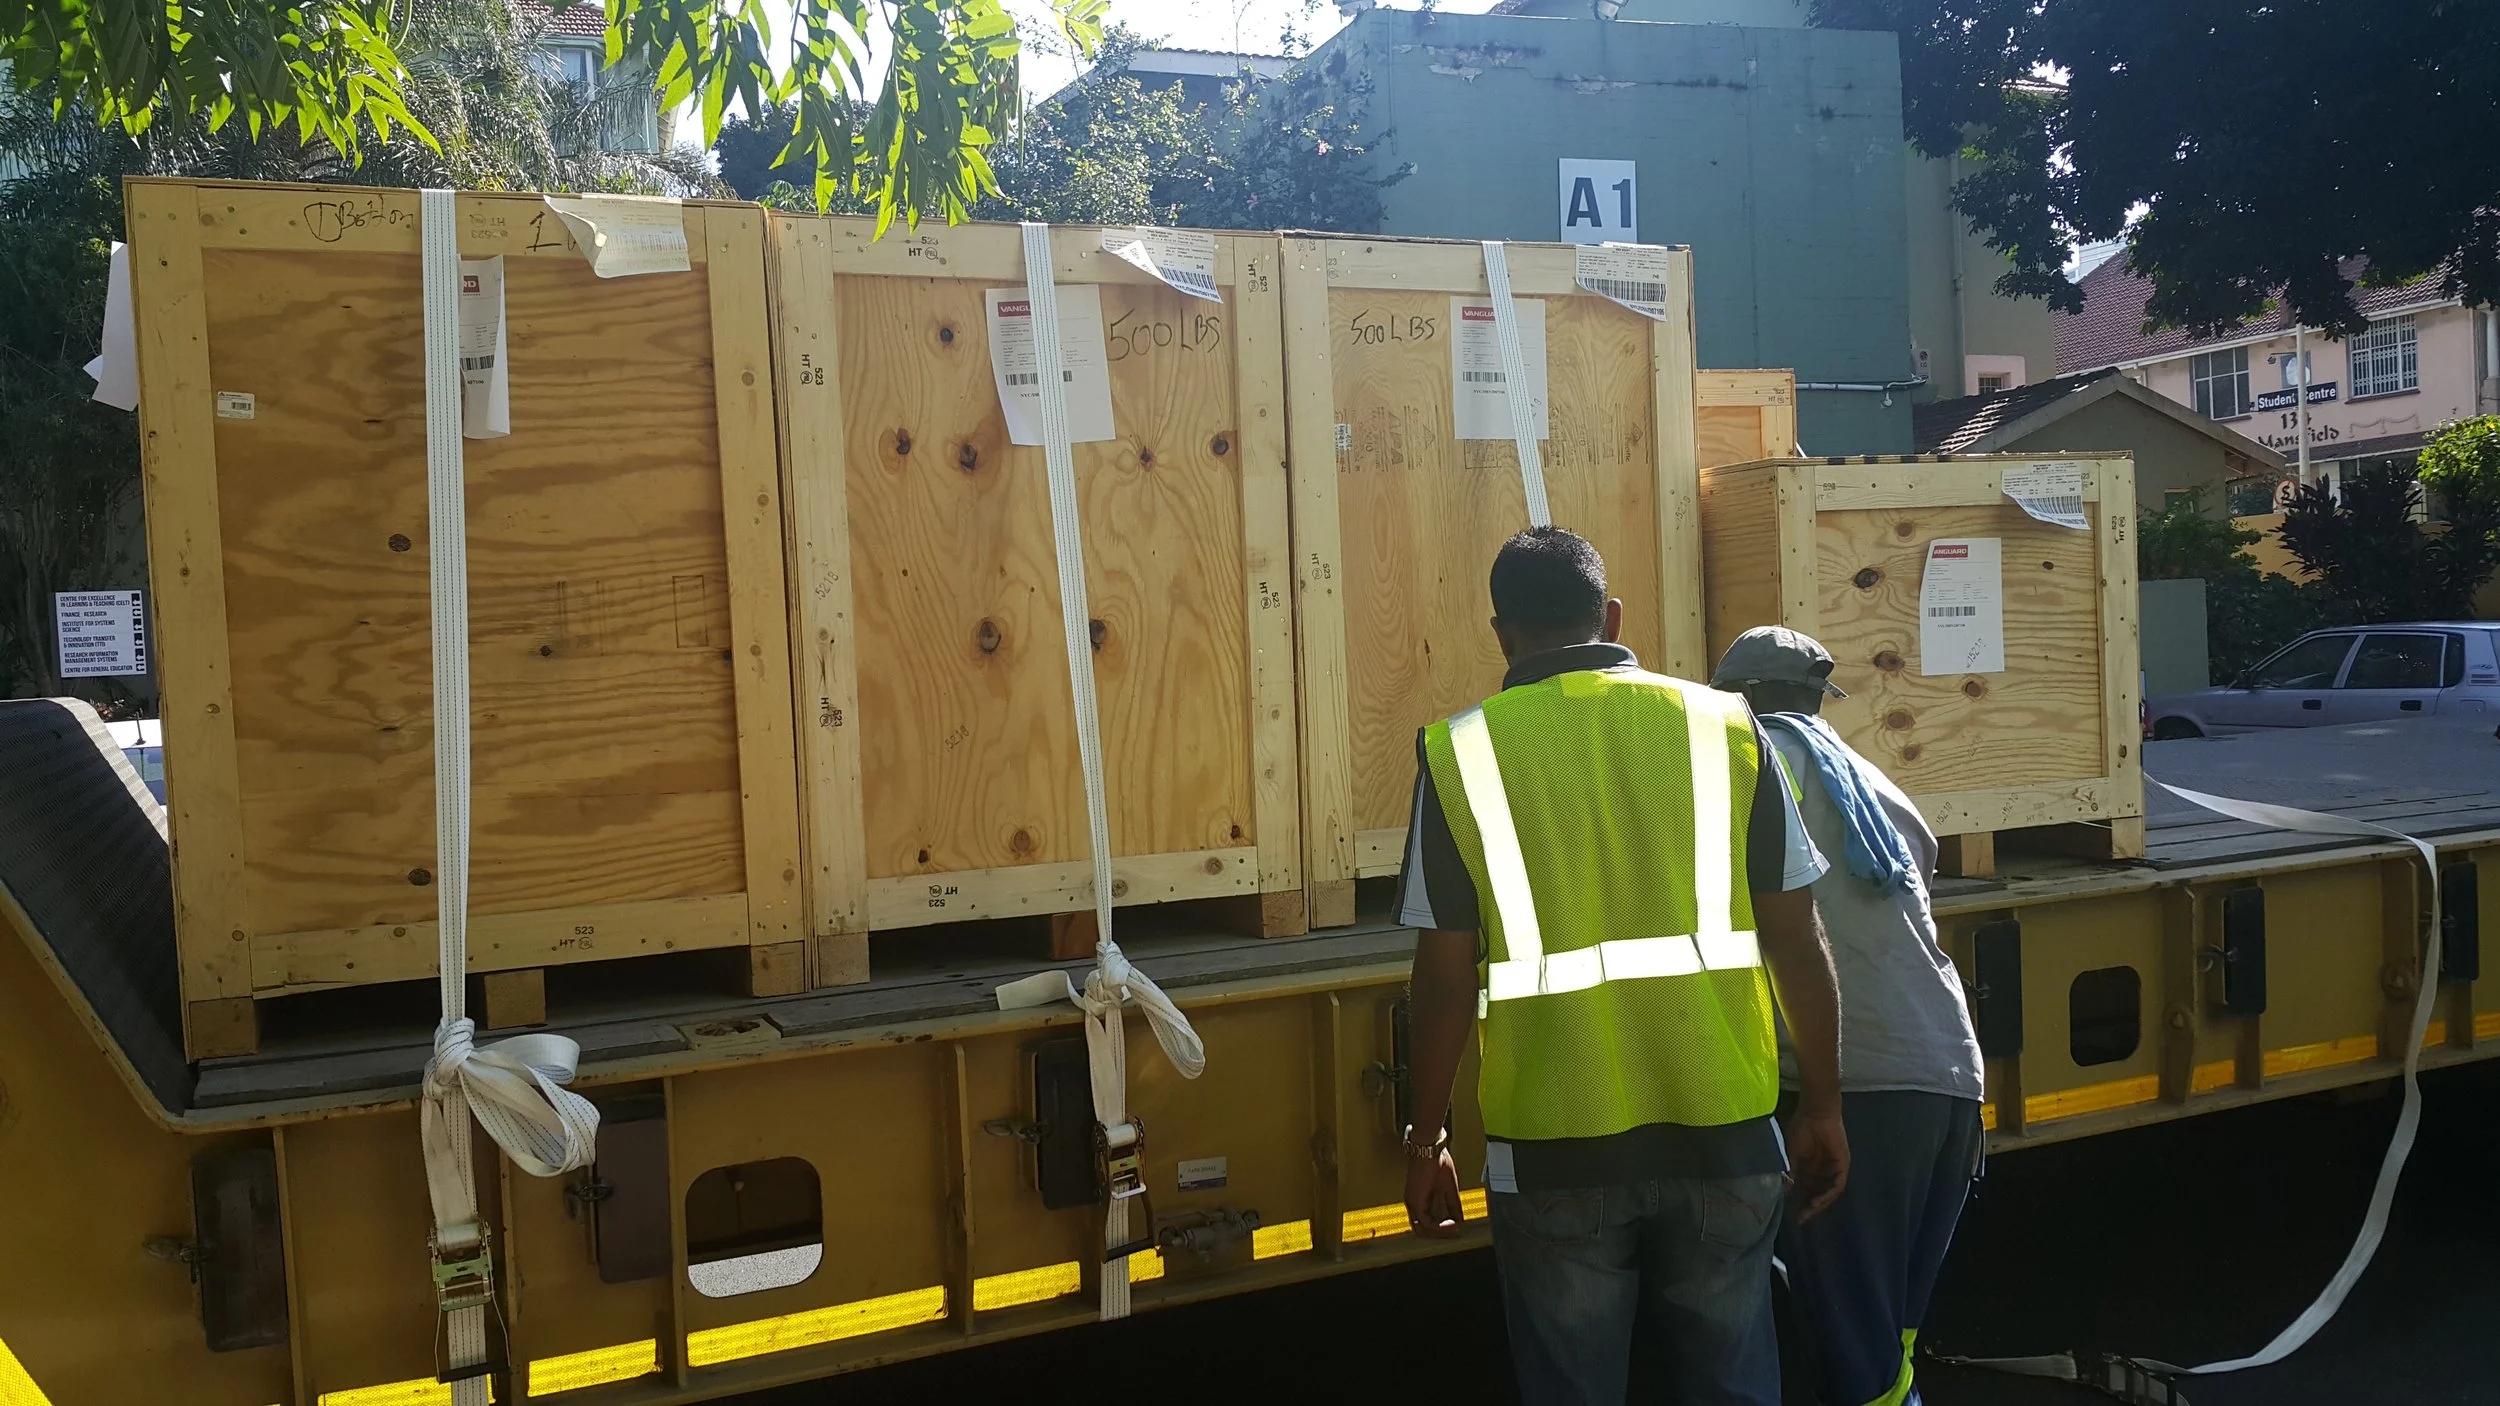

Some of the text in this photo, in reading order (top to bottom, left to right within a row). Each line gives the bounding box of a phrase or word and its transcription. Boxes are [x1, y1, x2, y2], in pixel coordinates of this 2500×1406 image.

[1566, 177, 1632, 228] A1
[921, 236, 939, 245] 523
[908, 248, 922, 256] HT
[1248, 264, 1256, 277] HT
[1259, 276, 1268, 292] 523
[1107, 308, 1172, 360] 500
[1350, 309, 1385, 345] 500
[802, 354, 811, 368] HT
[814, 367, 824, 386] 523
[2259, 388, 2336, 409] Student entre
[2258, 425, 2340, 448] Mansield
[1311, 553, 1320, 566] HT
[1323, 563, 1331, 580] 523
[1259, 582, 1268, 594] HT
[1272, 592, 1280, 608] 523
[820, 697, 829, 711] HT
[832, 709, 842, 727] 523
[945, 887, 957, 895] HT
[929, 899, 945, 908] 523
[575, 926, 594, 935] 523
[560, 939, 575, 948] HT
